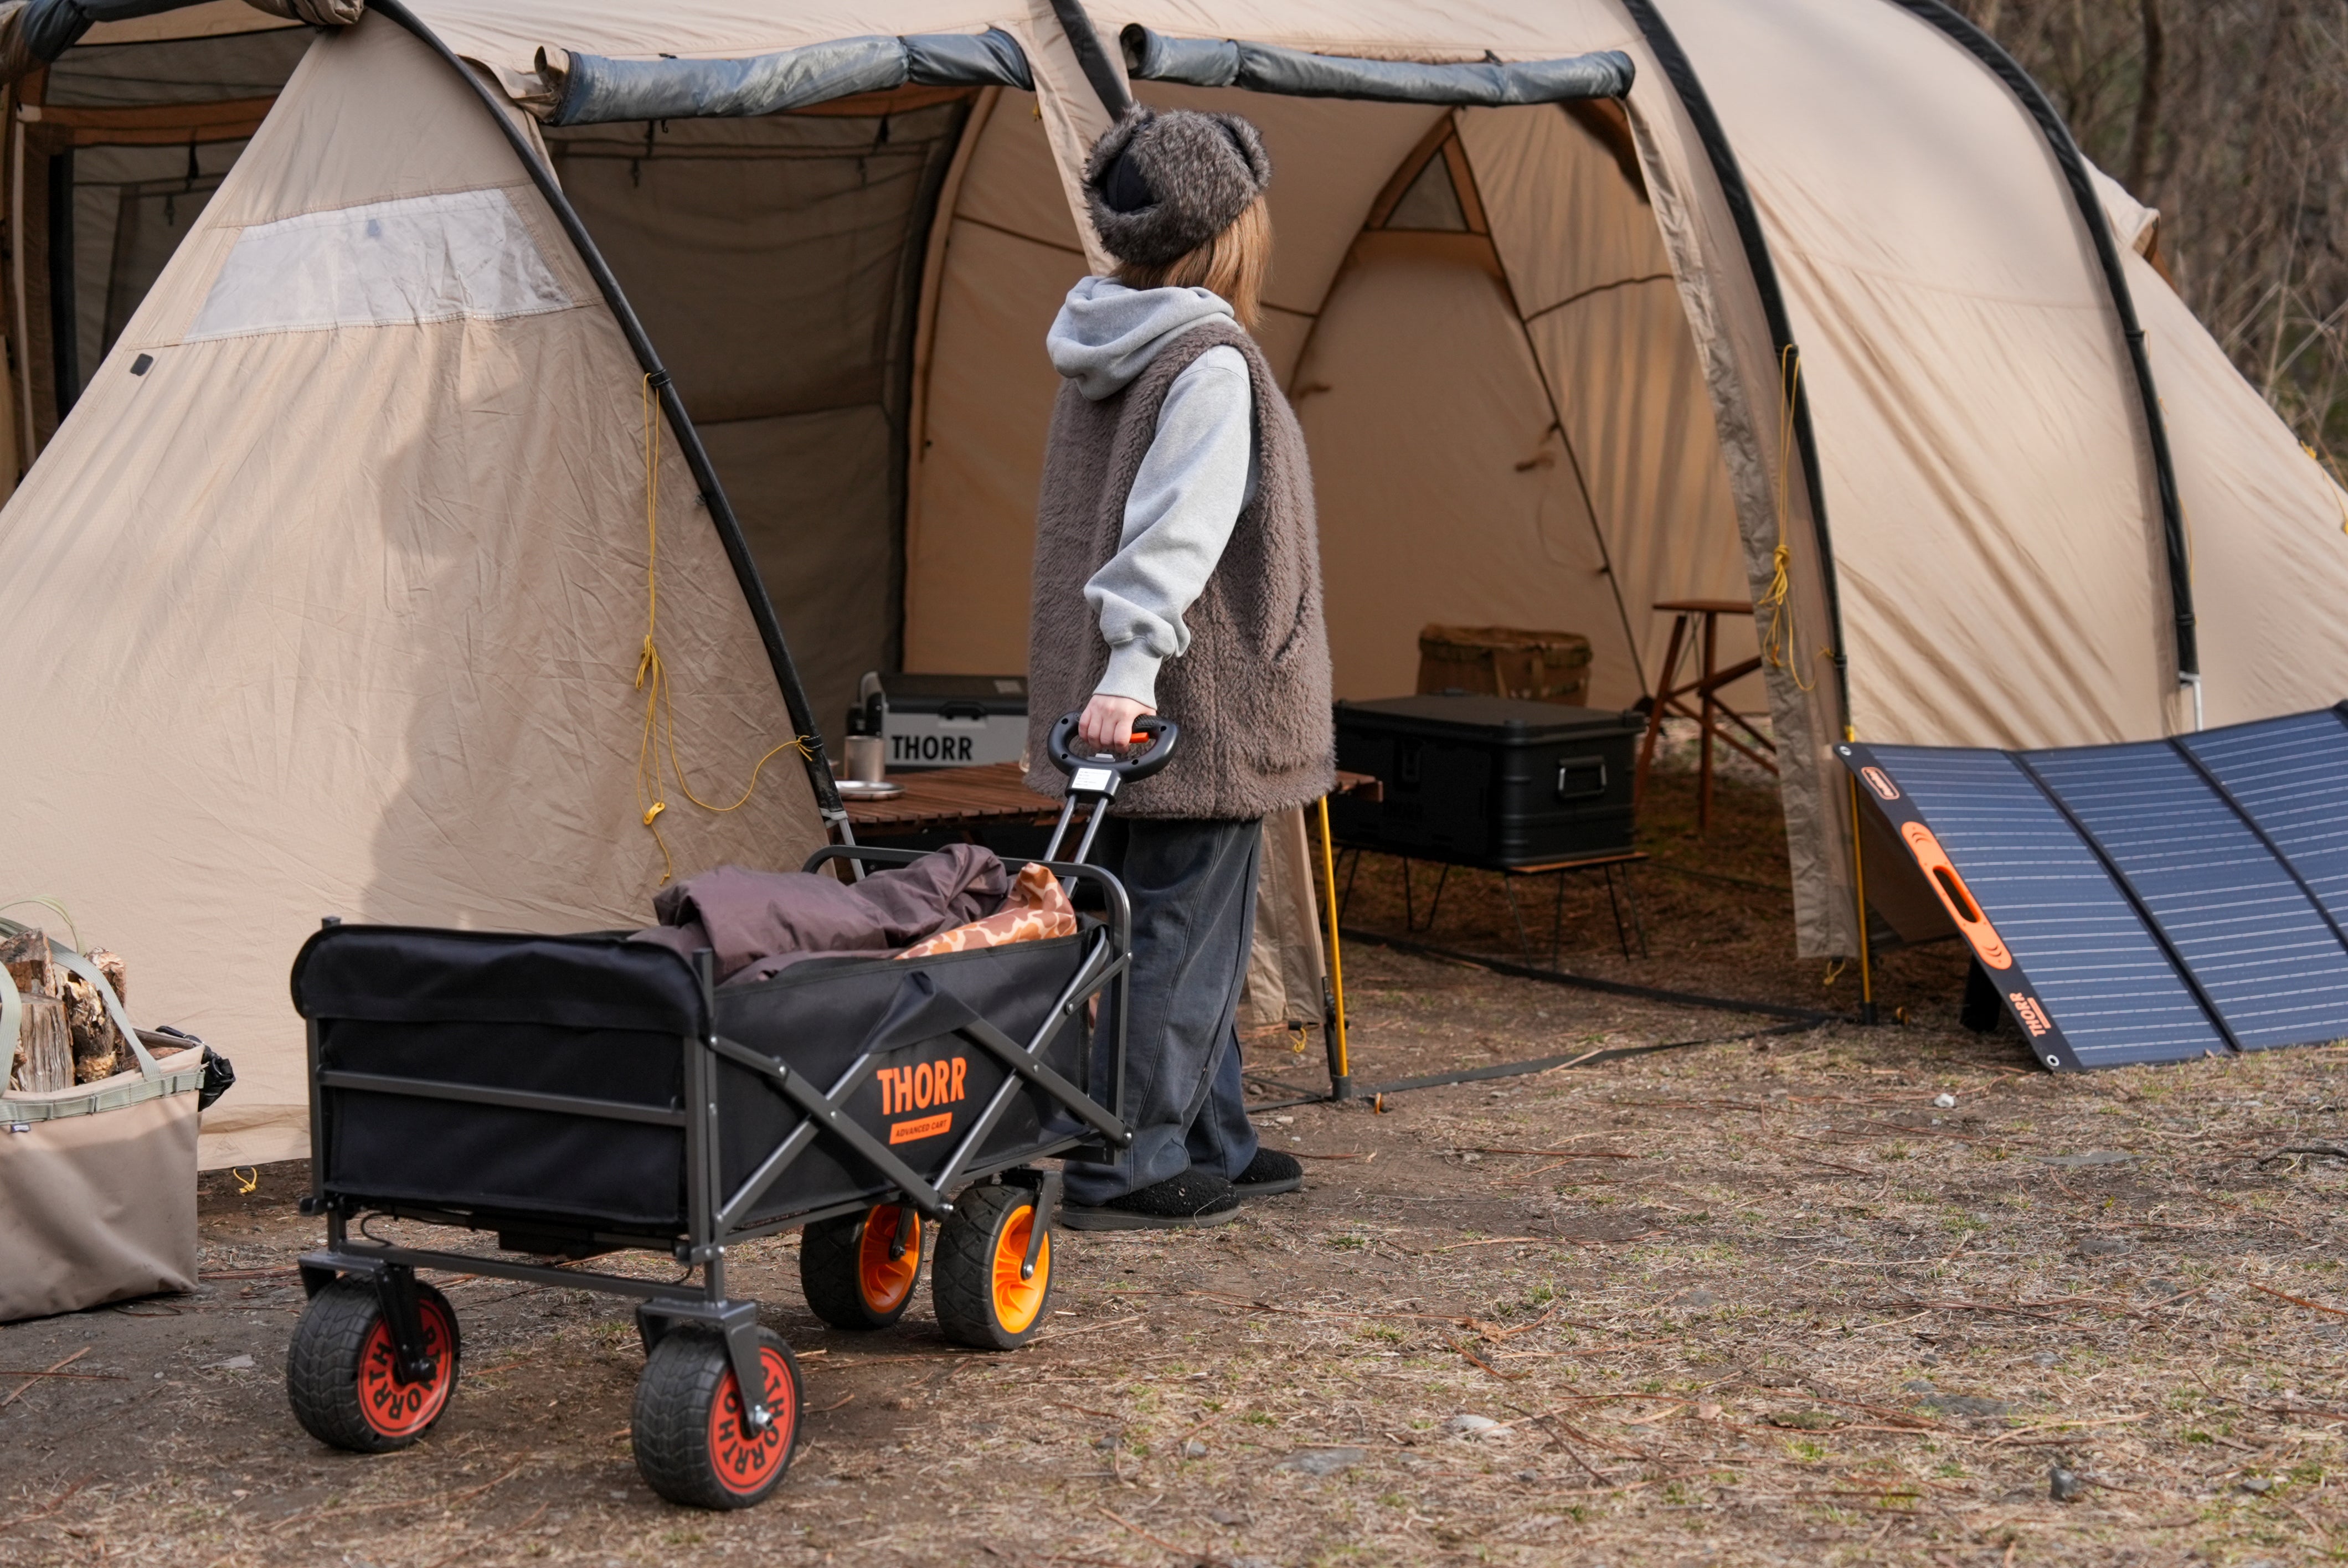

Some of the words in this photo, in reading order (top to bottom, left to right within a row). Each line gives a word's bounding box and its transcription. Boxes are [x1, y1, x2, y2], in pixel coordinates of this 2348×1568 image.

[891, 735, 972, 761] THORR
[2009, 992, 2046, 1037] THORR
[877, 1056, 967, 1116] THORR
[895, 1123, 930, 1137] ADVANCED
[931, 1119, 948, 1130] CART
